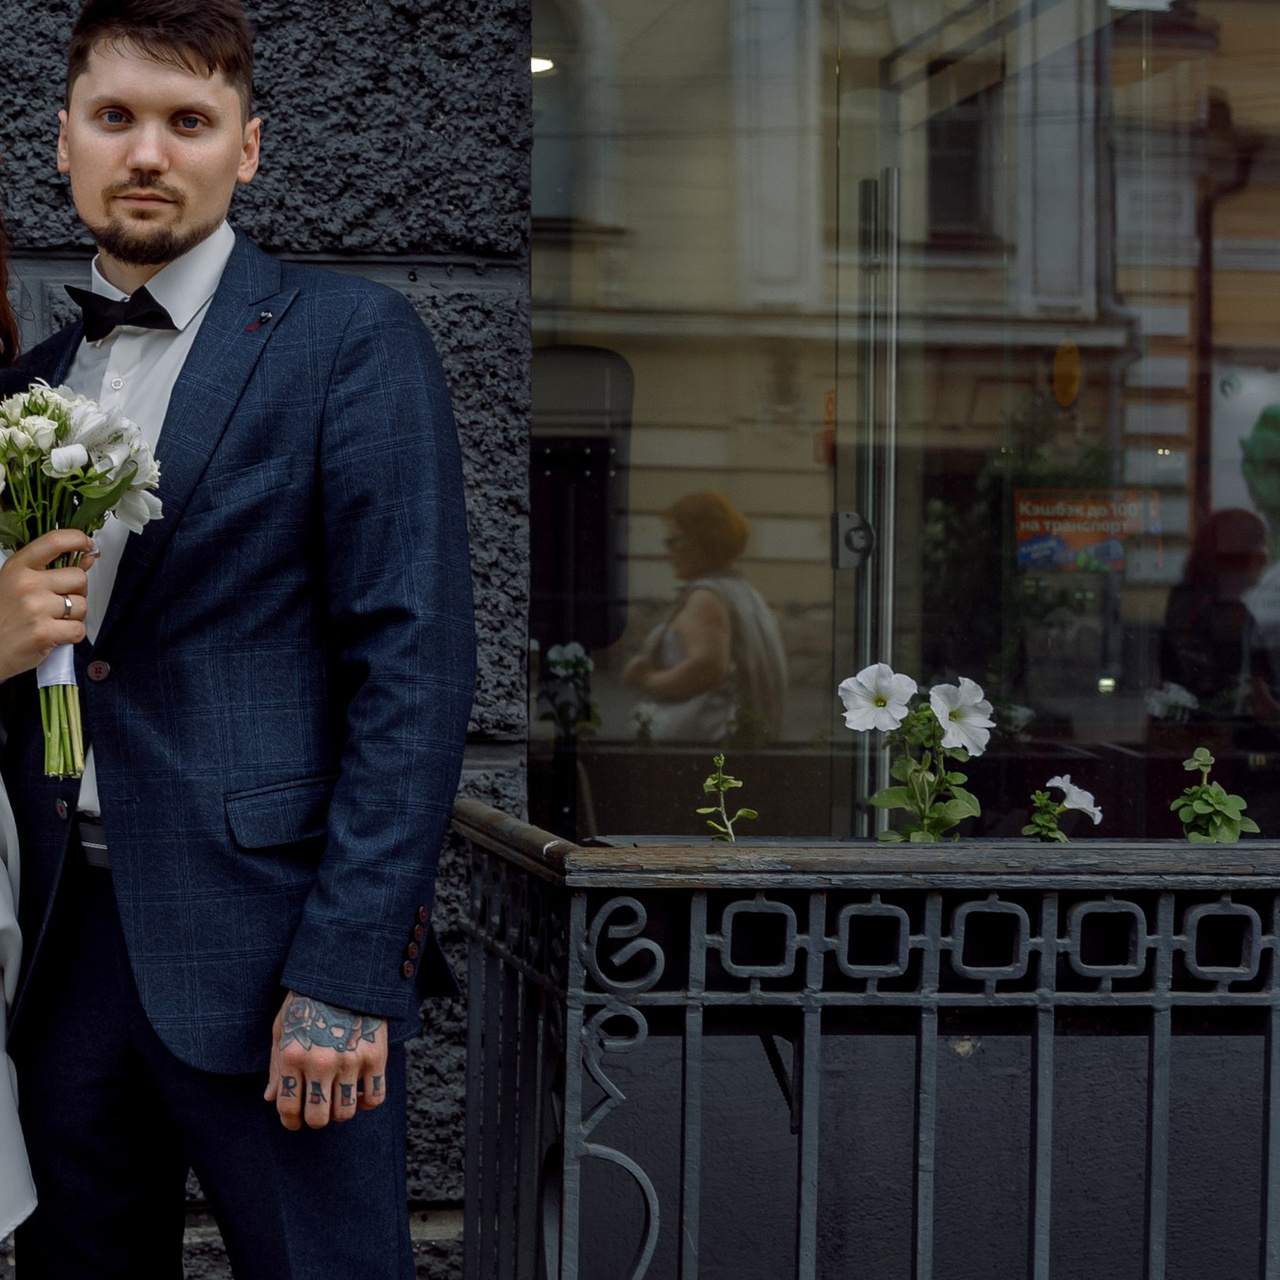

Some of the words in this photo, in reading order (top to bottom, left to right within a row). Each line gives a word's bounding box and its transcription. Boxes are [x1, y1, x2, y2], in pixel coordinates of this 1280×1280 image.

[1019, 501, 1084, 517] Кэшбэк
[1087, 505, 1109, 518] до
[1020, 520, 1041, 532] на
[1043, 520, 1131, 534] транспорт
